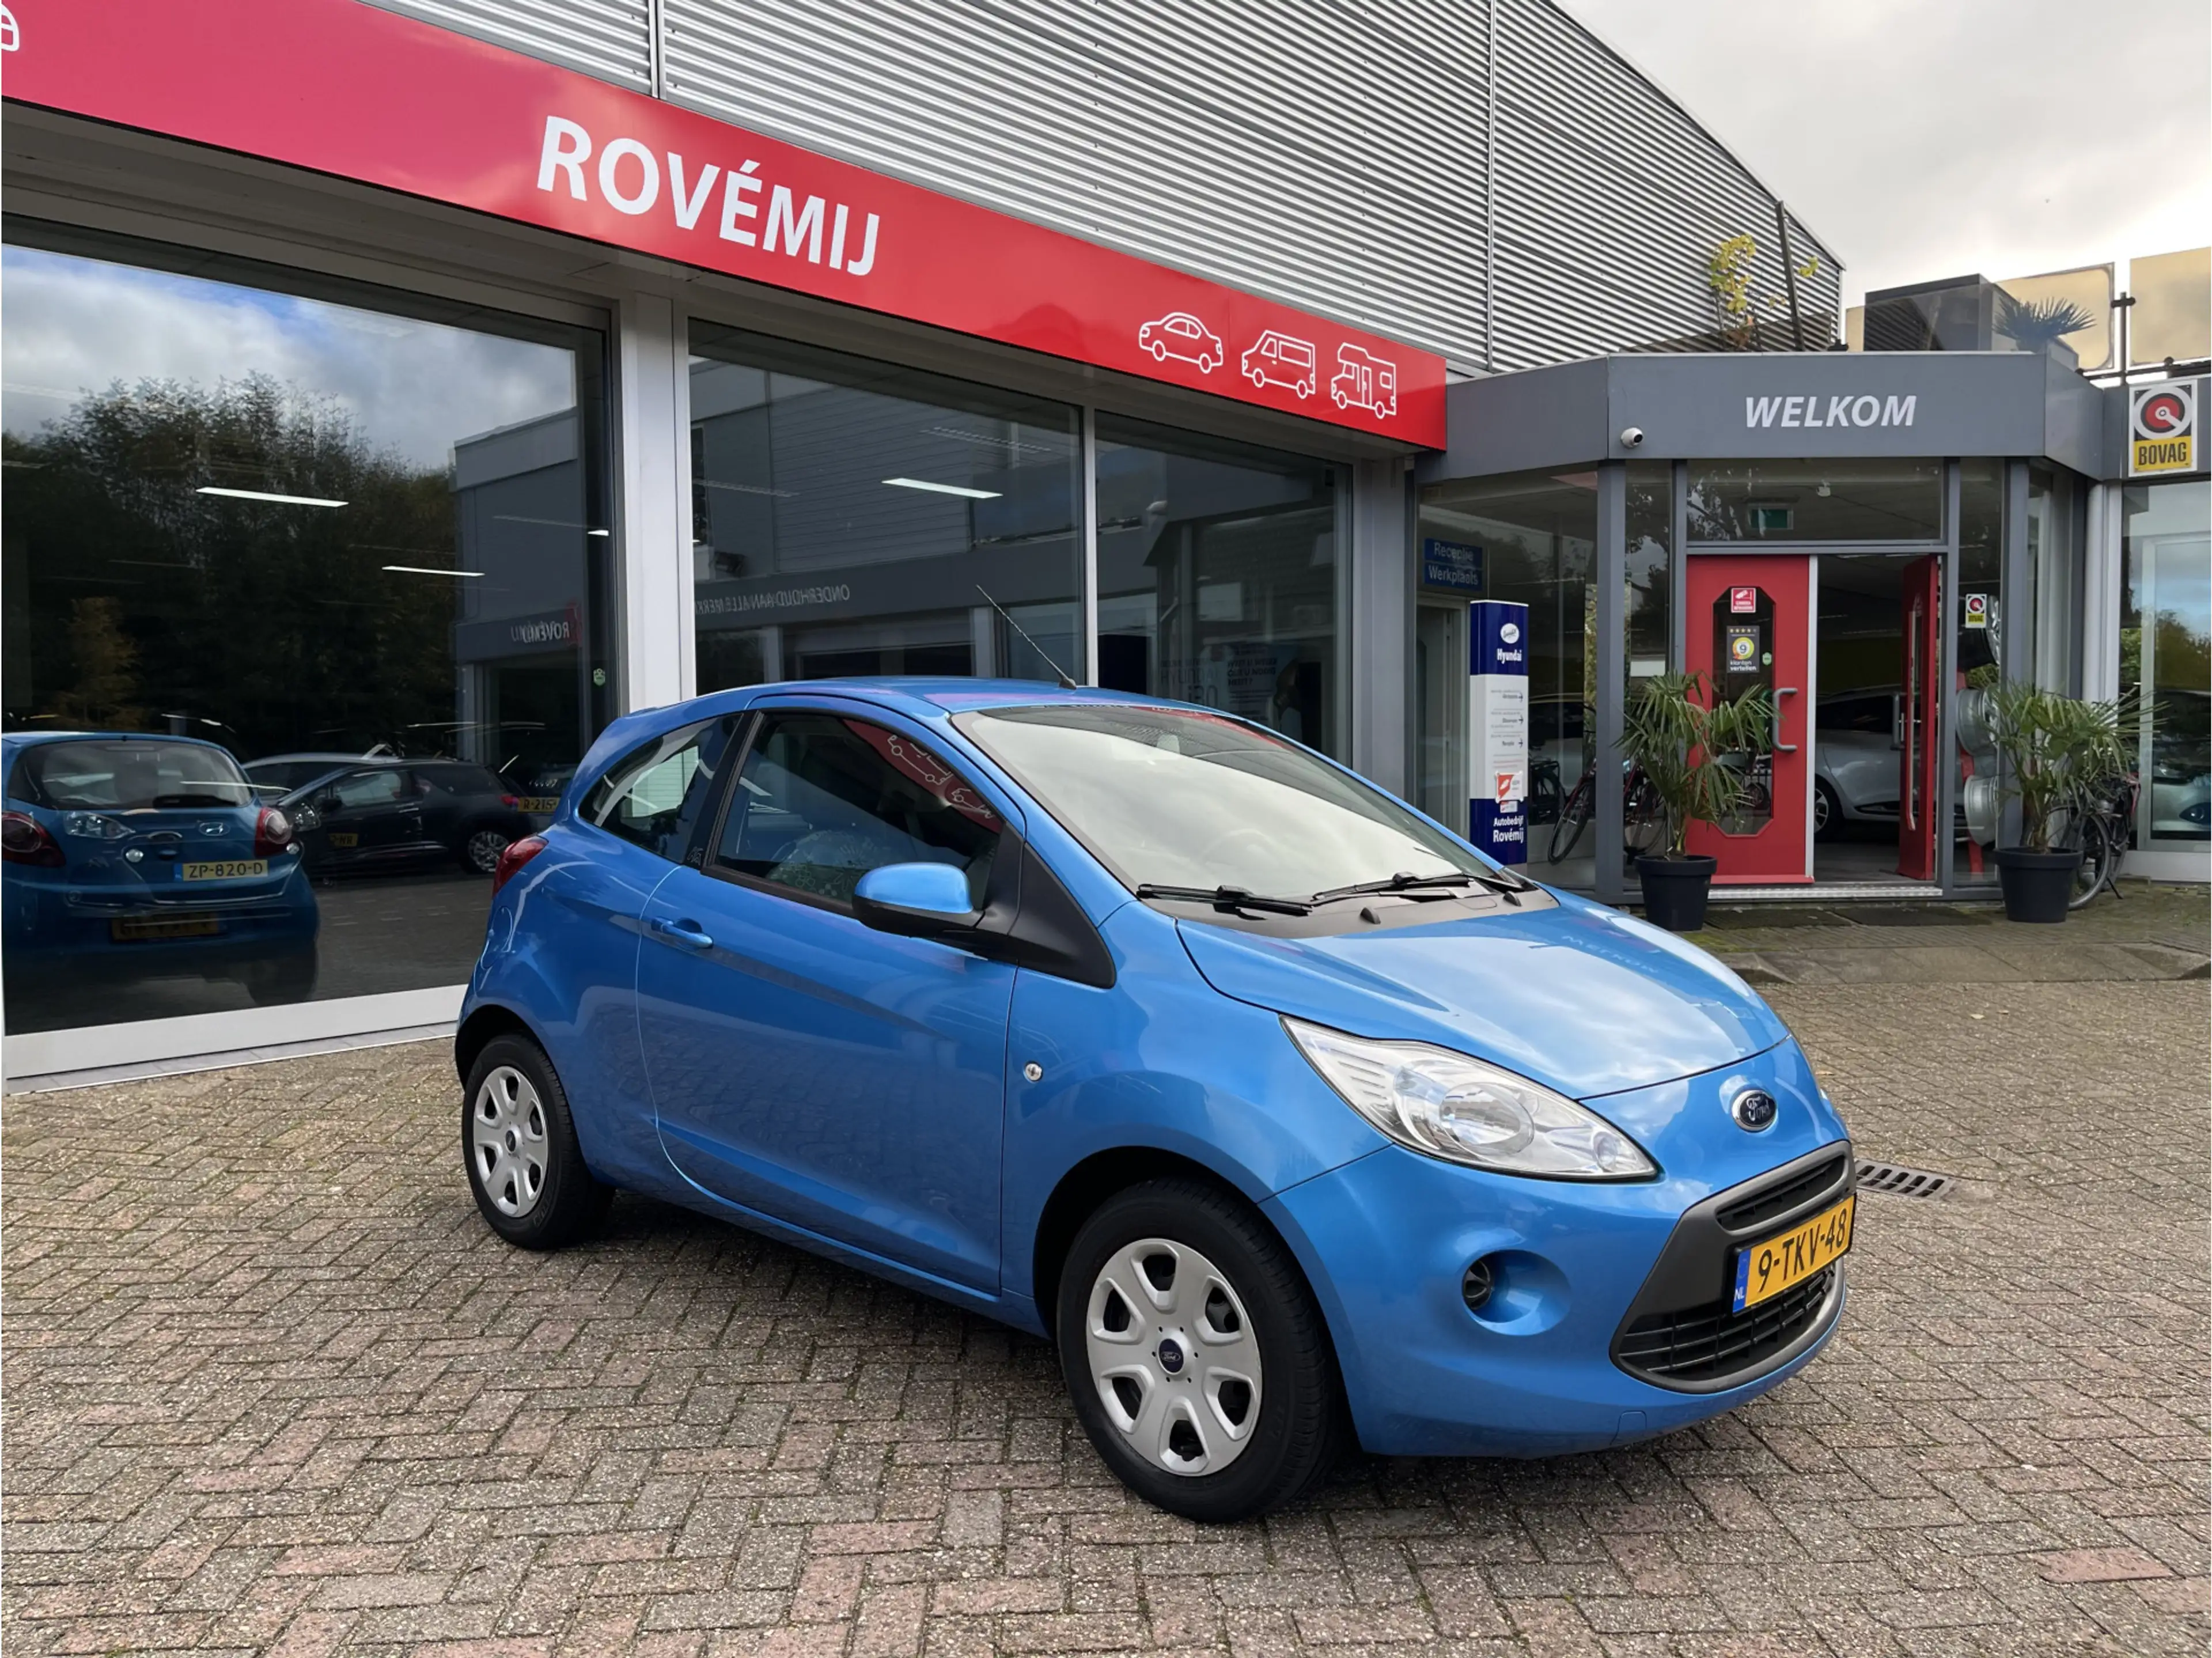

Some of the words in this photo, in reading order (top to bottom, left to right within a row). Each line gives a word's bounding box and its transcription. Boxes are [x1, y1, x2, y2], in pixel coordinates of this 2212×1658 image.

[537, 116, 880, 276] ROVÉMIJ
[1745, 395, 1916, 427] WELKOM
[2138, 442, 2187, 465] BOVAG
[1428, 564, 1479, 586] Werkplaats
[1497, 648, 1522, 664] Hyundai
[1493, 815, 1524, 827] Autobedrijf
[1493, 827, 1524, 843] Rovémij
[189, 862, 263, 879] ZP-820-D
[1746, 1096, 1770, 1122] Ford
[1758, 1207, 1847, 1293] 9-TKV-48
[1734, 1286, 1745, 1301] NL
